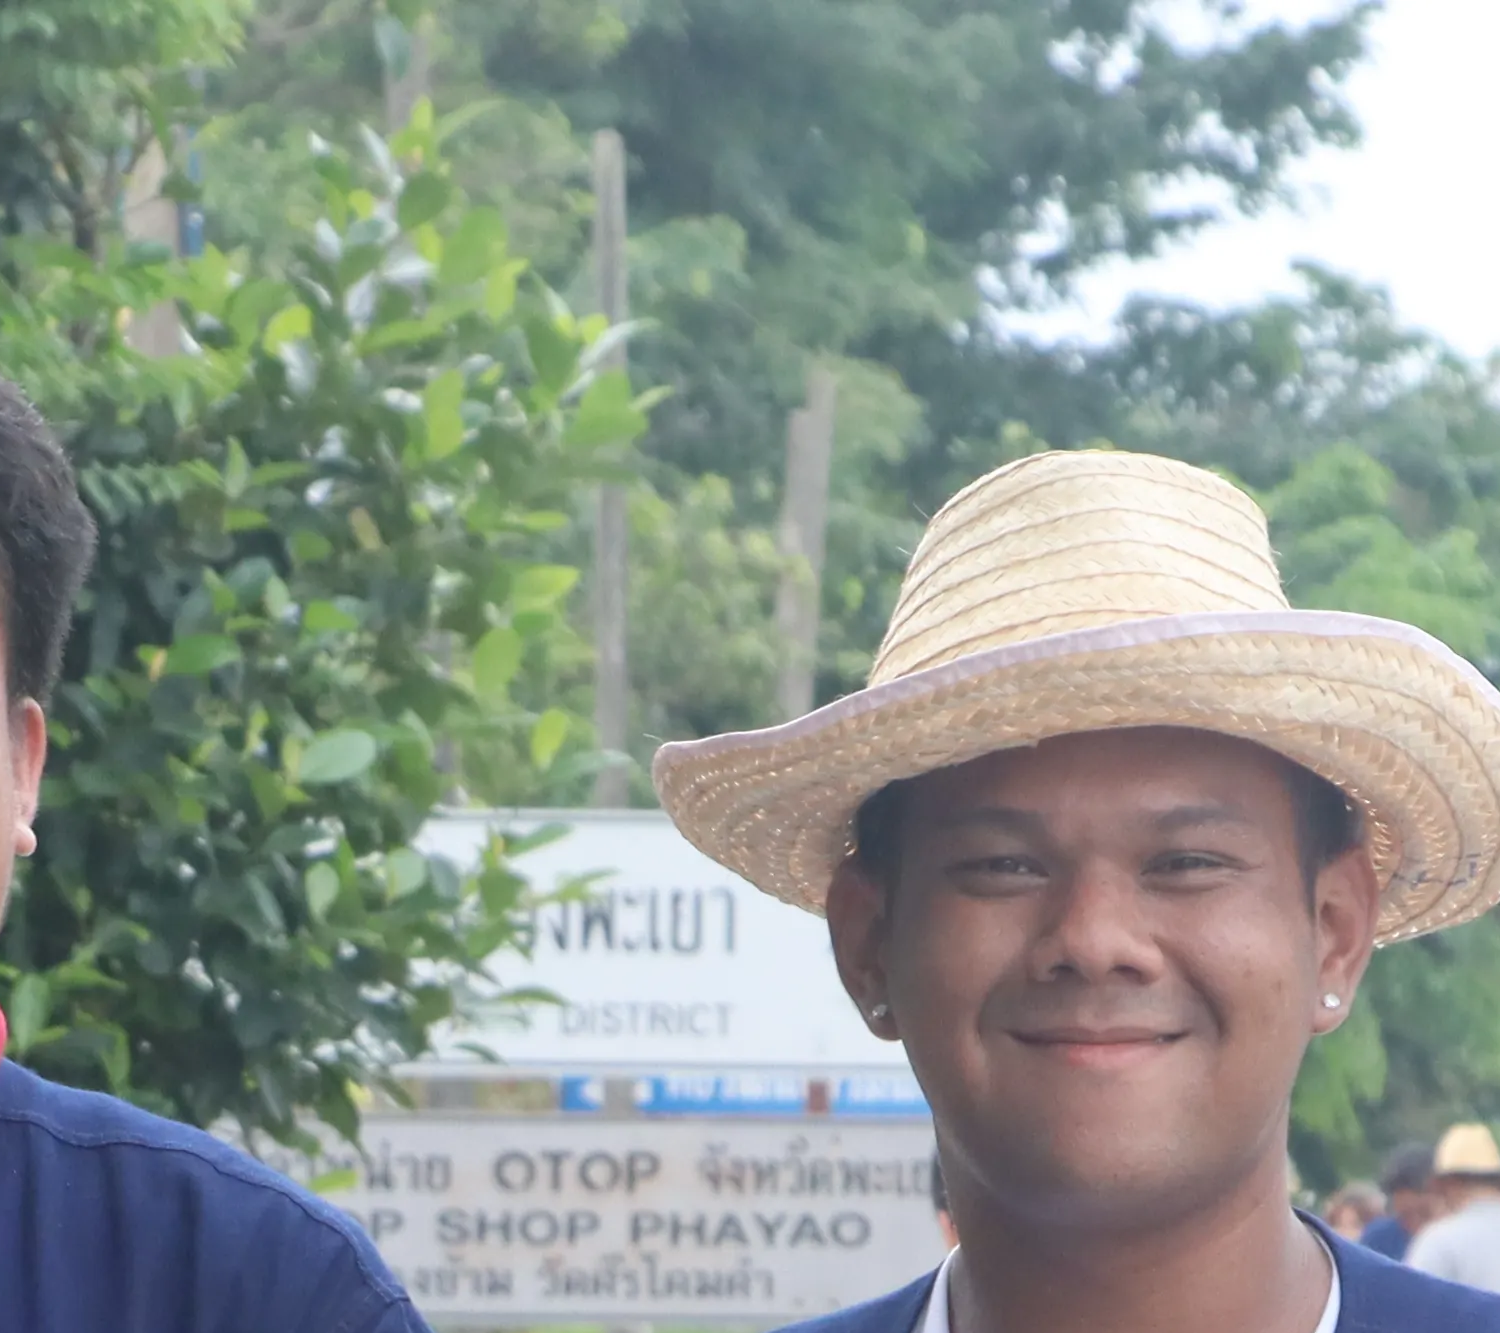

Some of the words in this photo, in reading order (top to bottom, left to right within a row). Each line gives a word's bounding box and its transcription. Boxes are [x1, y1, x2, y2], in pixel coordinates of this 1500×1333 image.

[527, 884, 738, 955] งพะเยา
[561, 1001, 736, 1038] DISTRICT
[492, 1149, 663, 1195] OTOP
[437, 1208, 602, 1248] SHOP
[630, 1209, 872, 1249] PHAYAO
